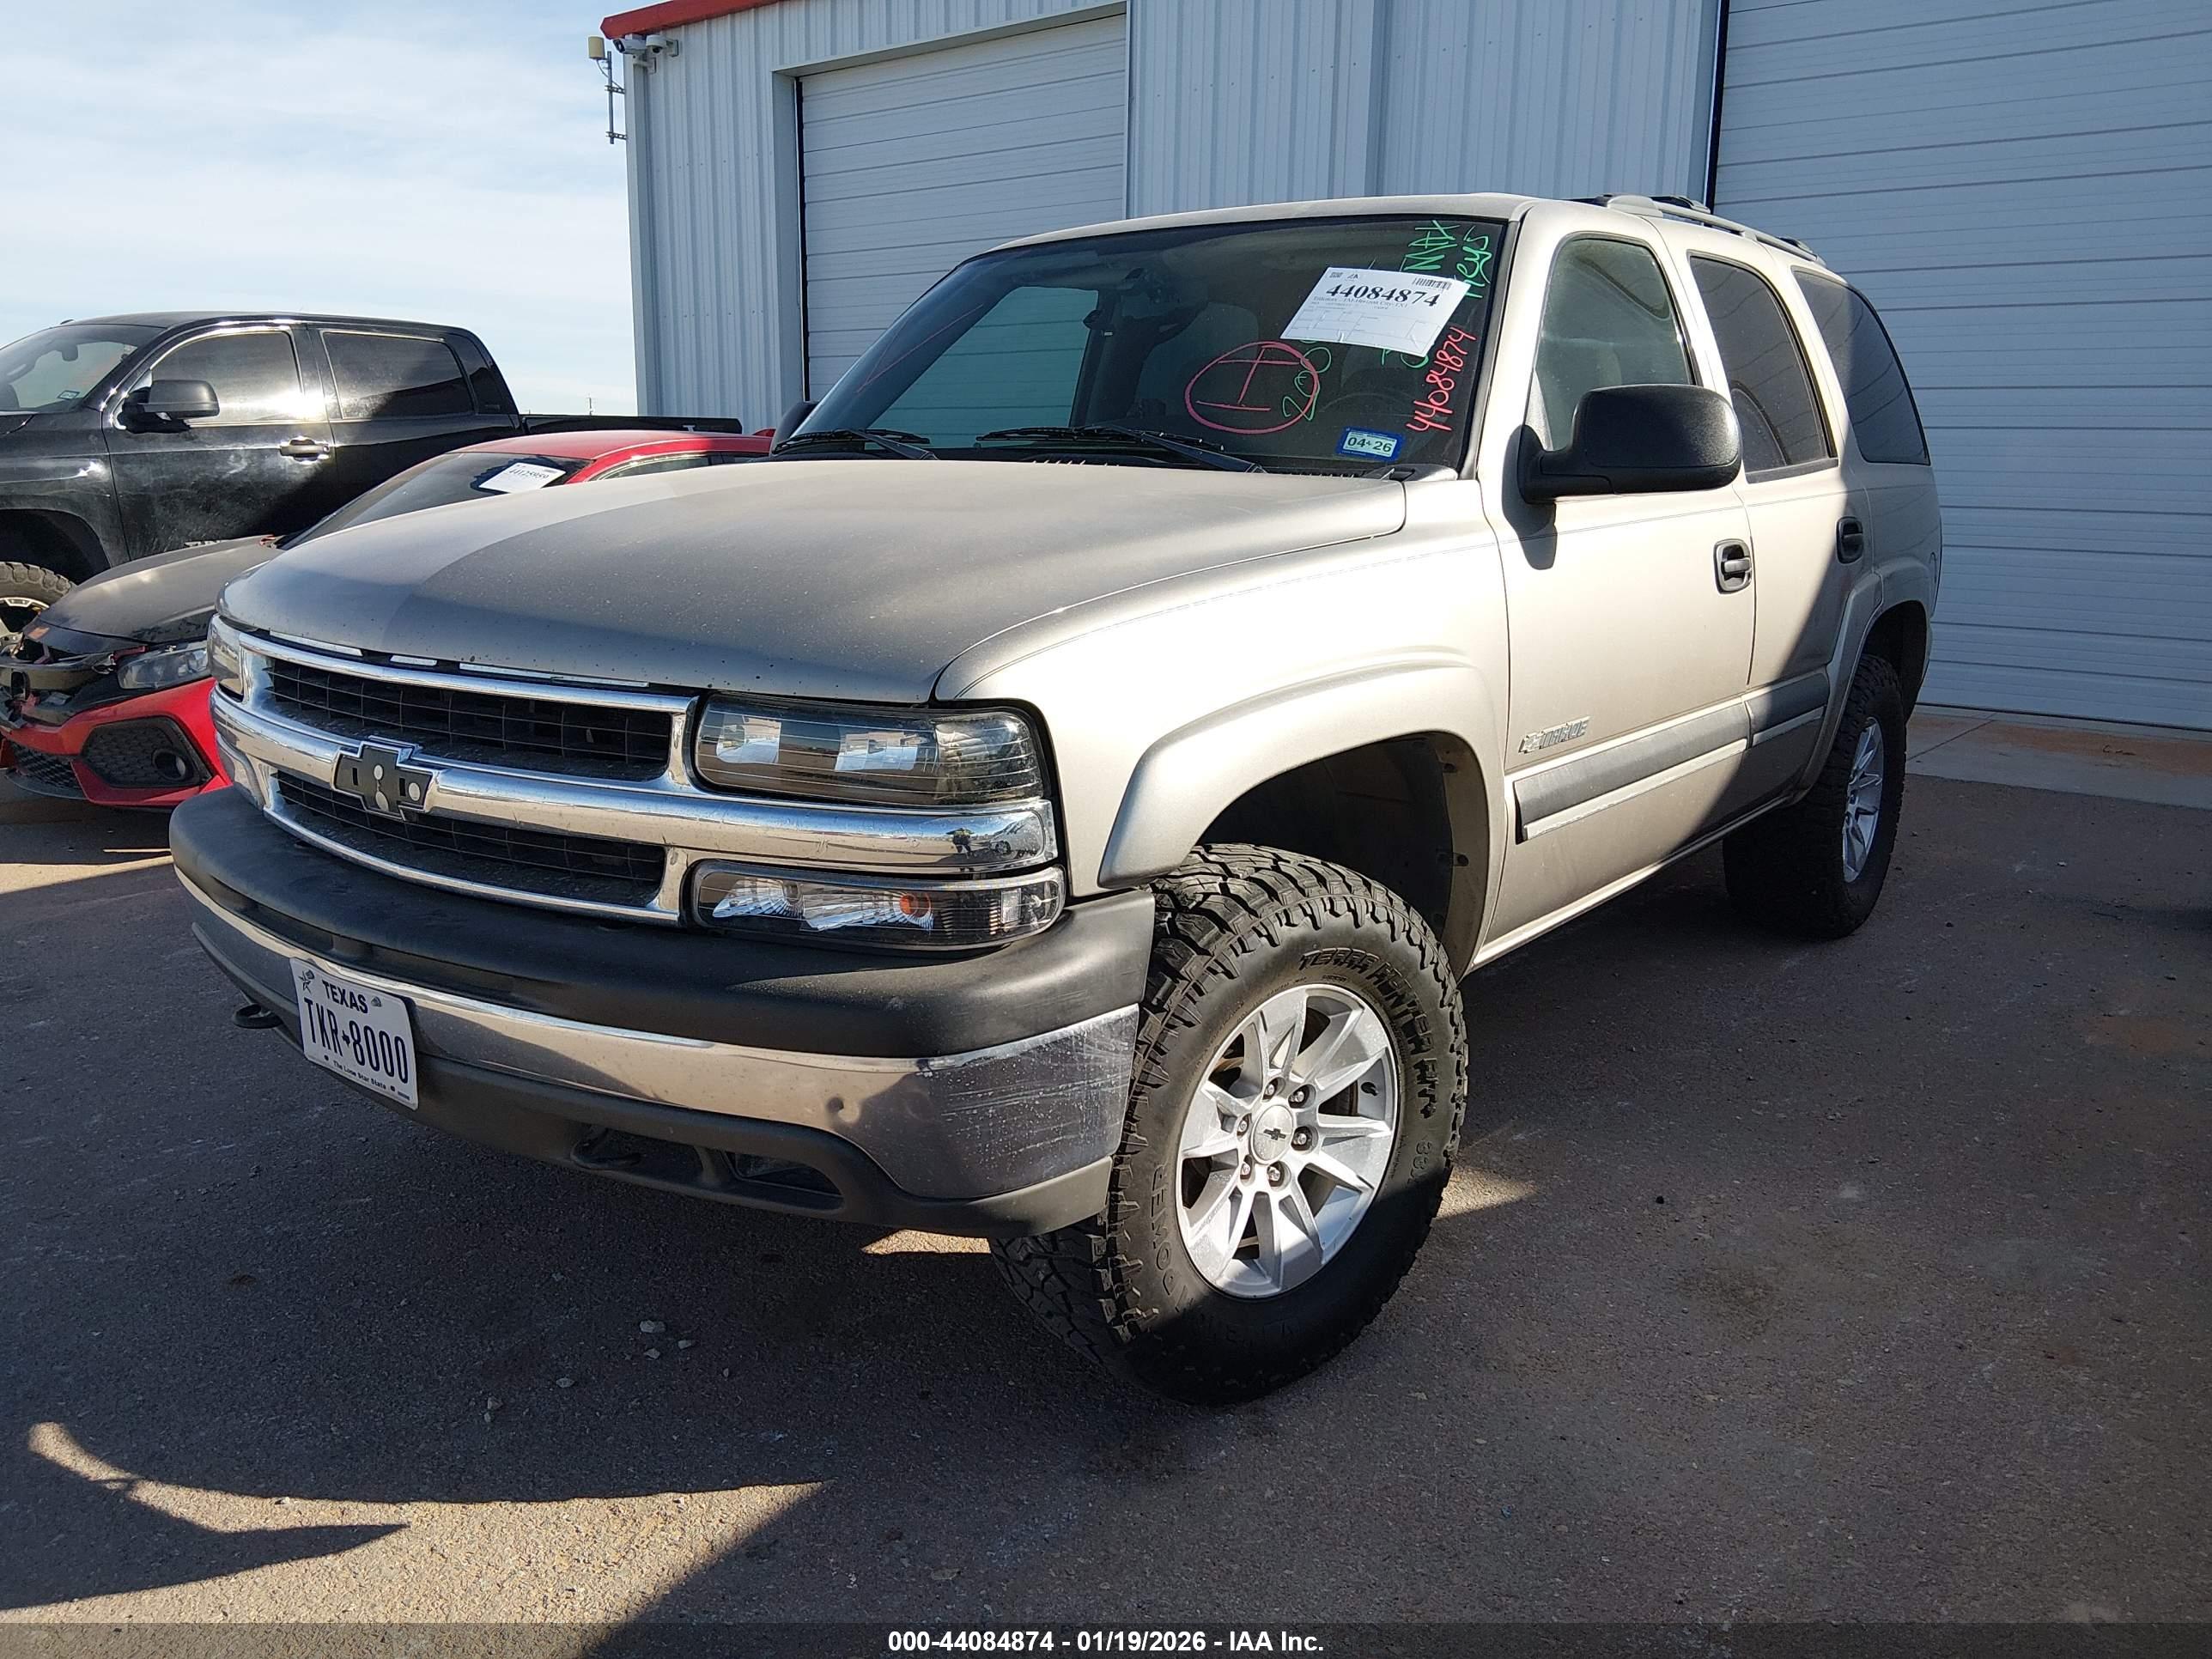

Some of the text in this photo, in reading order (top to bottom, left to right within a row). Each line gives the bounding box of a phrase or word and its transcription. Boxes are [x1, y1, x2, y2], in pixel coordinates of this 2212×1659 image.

[1326, 283, 1441, 307] 44084874
[1406, 326, 1477, 432] 44084874
[1347, 437, 1393, 453] 04 26
[322, 980, 368, 1014] TEXAS
